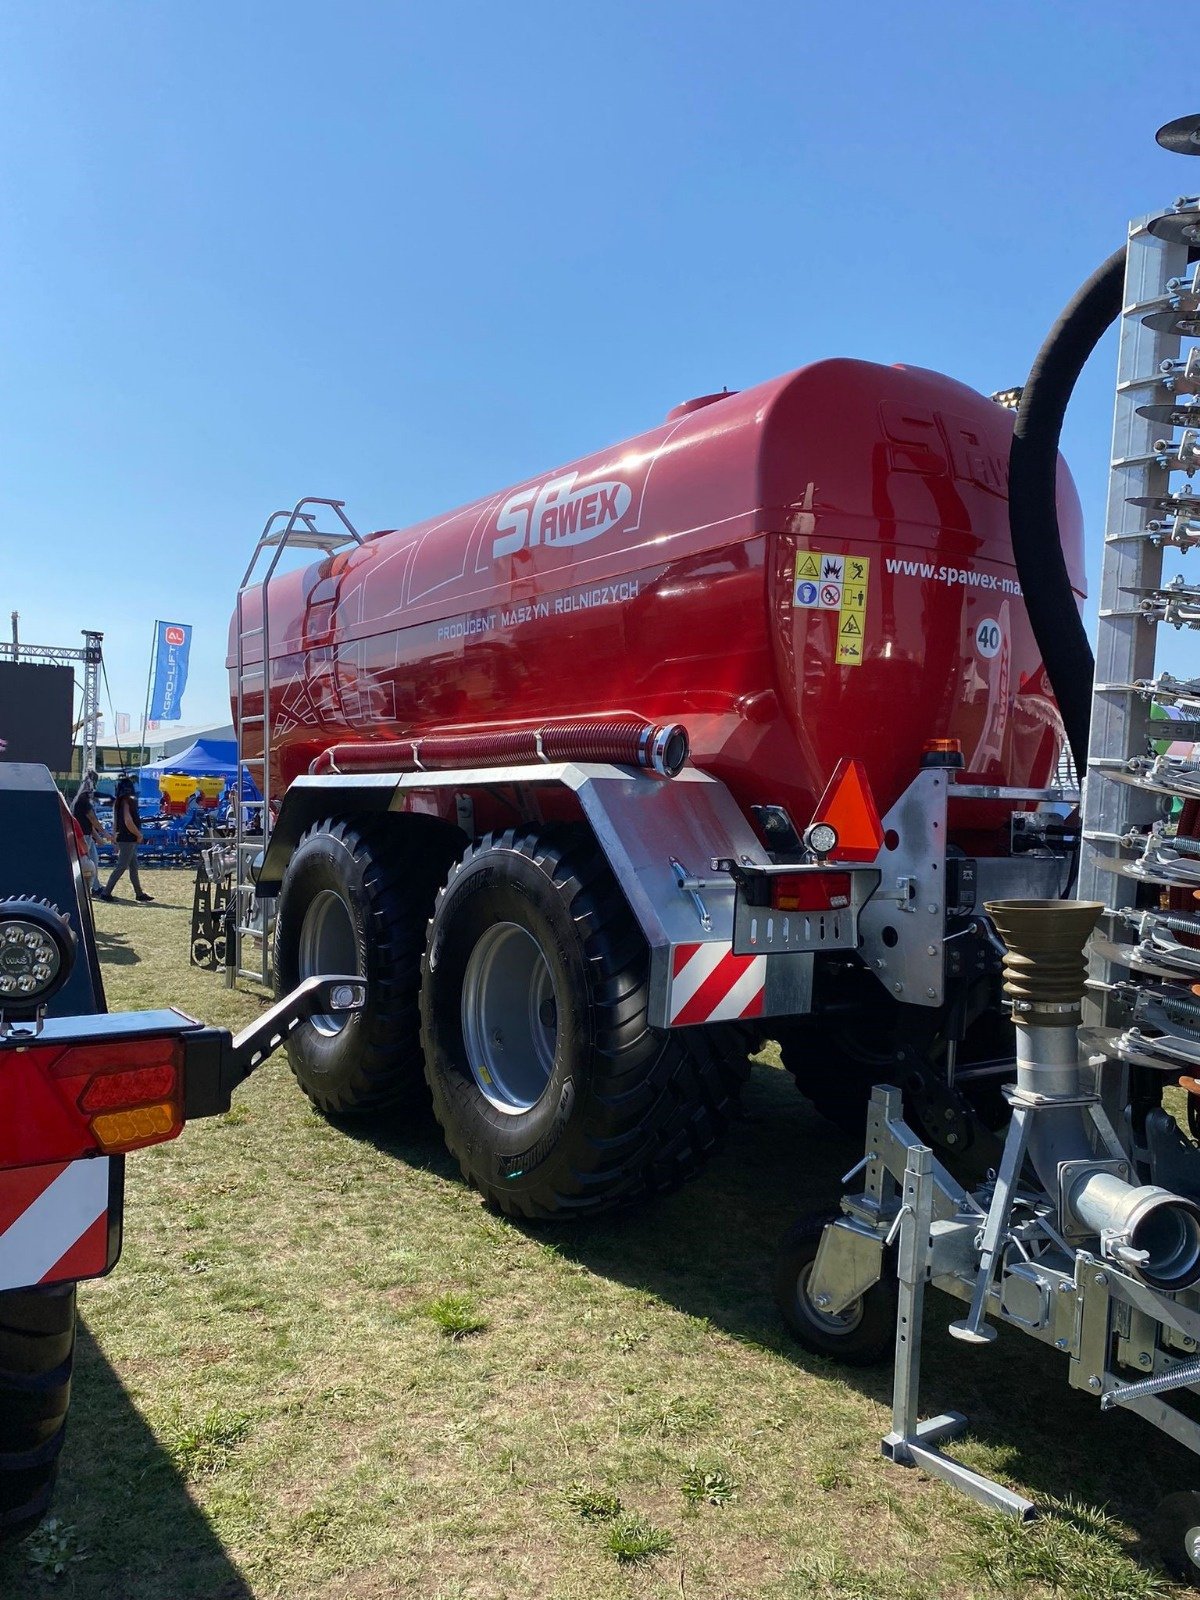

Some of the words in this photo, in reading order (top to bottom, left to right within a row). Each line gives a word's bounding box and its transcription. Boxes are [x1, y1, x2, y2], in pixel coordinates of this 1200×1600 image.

[886, 558, 1024, 596] www.spawex-ma
[437, 614, 497, 641] PRODUCENT
[501, 601, 549, 627] MASZYN
[555, 580, 639, 615] ROLNICZYCH
[978, 625, 999, 650] 40
[161, 645, 176, 719] AGRO-LIFT
